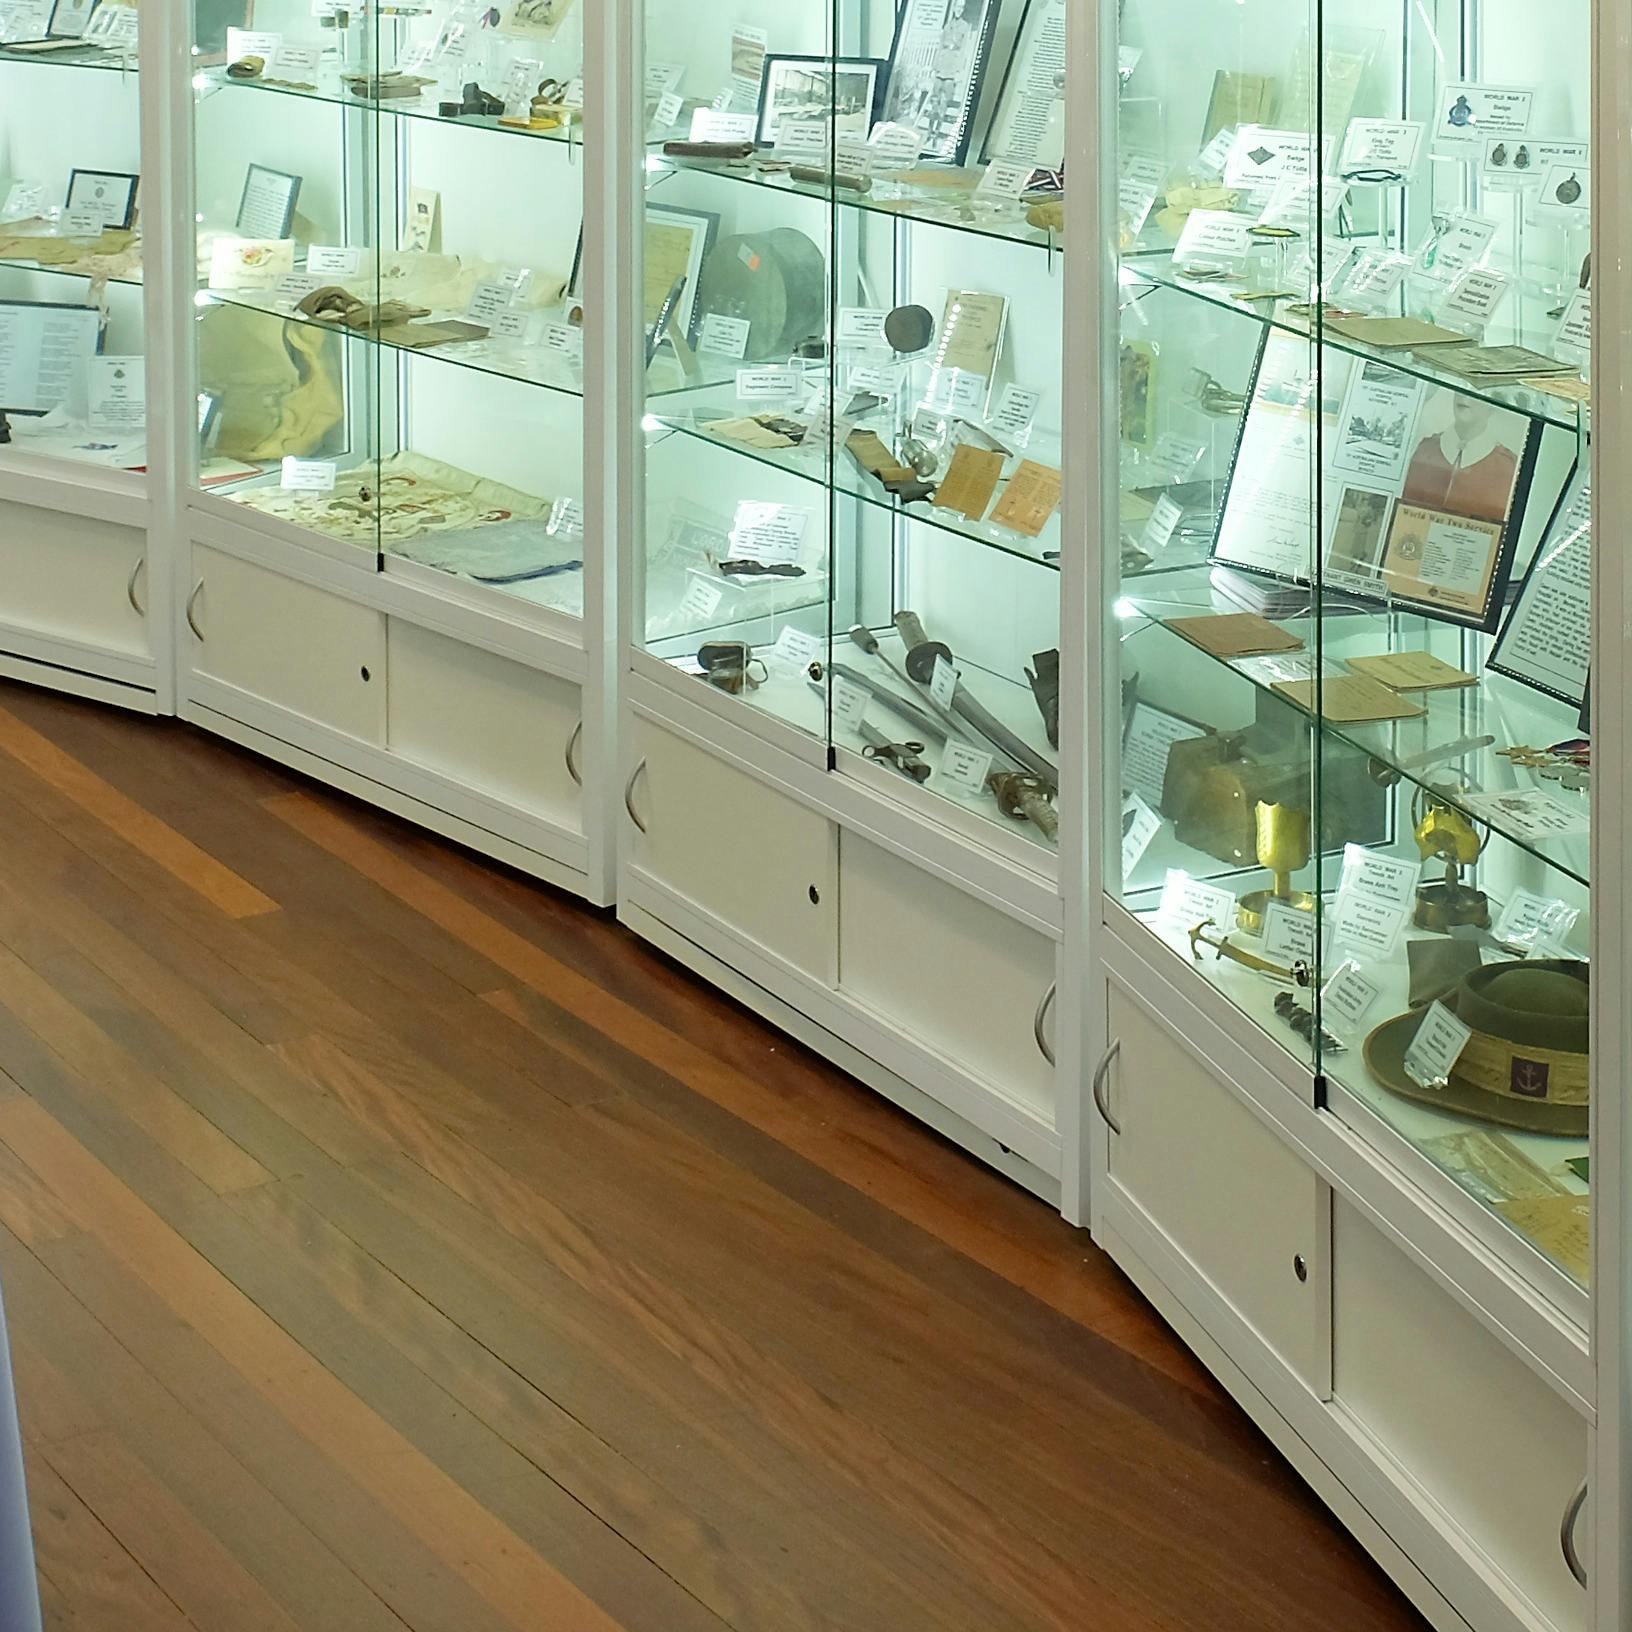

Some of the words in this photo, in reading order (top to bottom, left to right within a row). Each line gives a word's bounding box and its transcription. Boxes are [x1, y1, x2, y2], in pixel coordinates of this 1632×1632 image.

[1403, 508, 1426, 520] World
[1447, 518, 1462, 528] Two
[1463, 522, 1495, 535] Service
